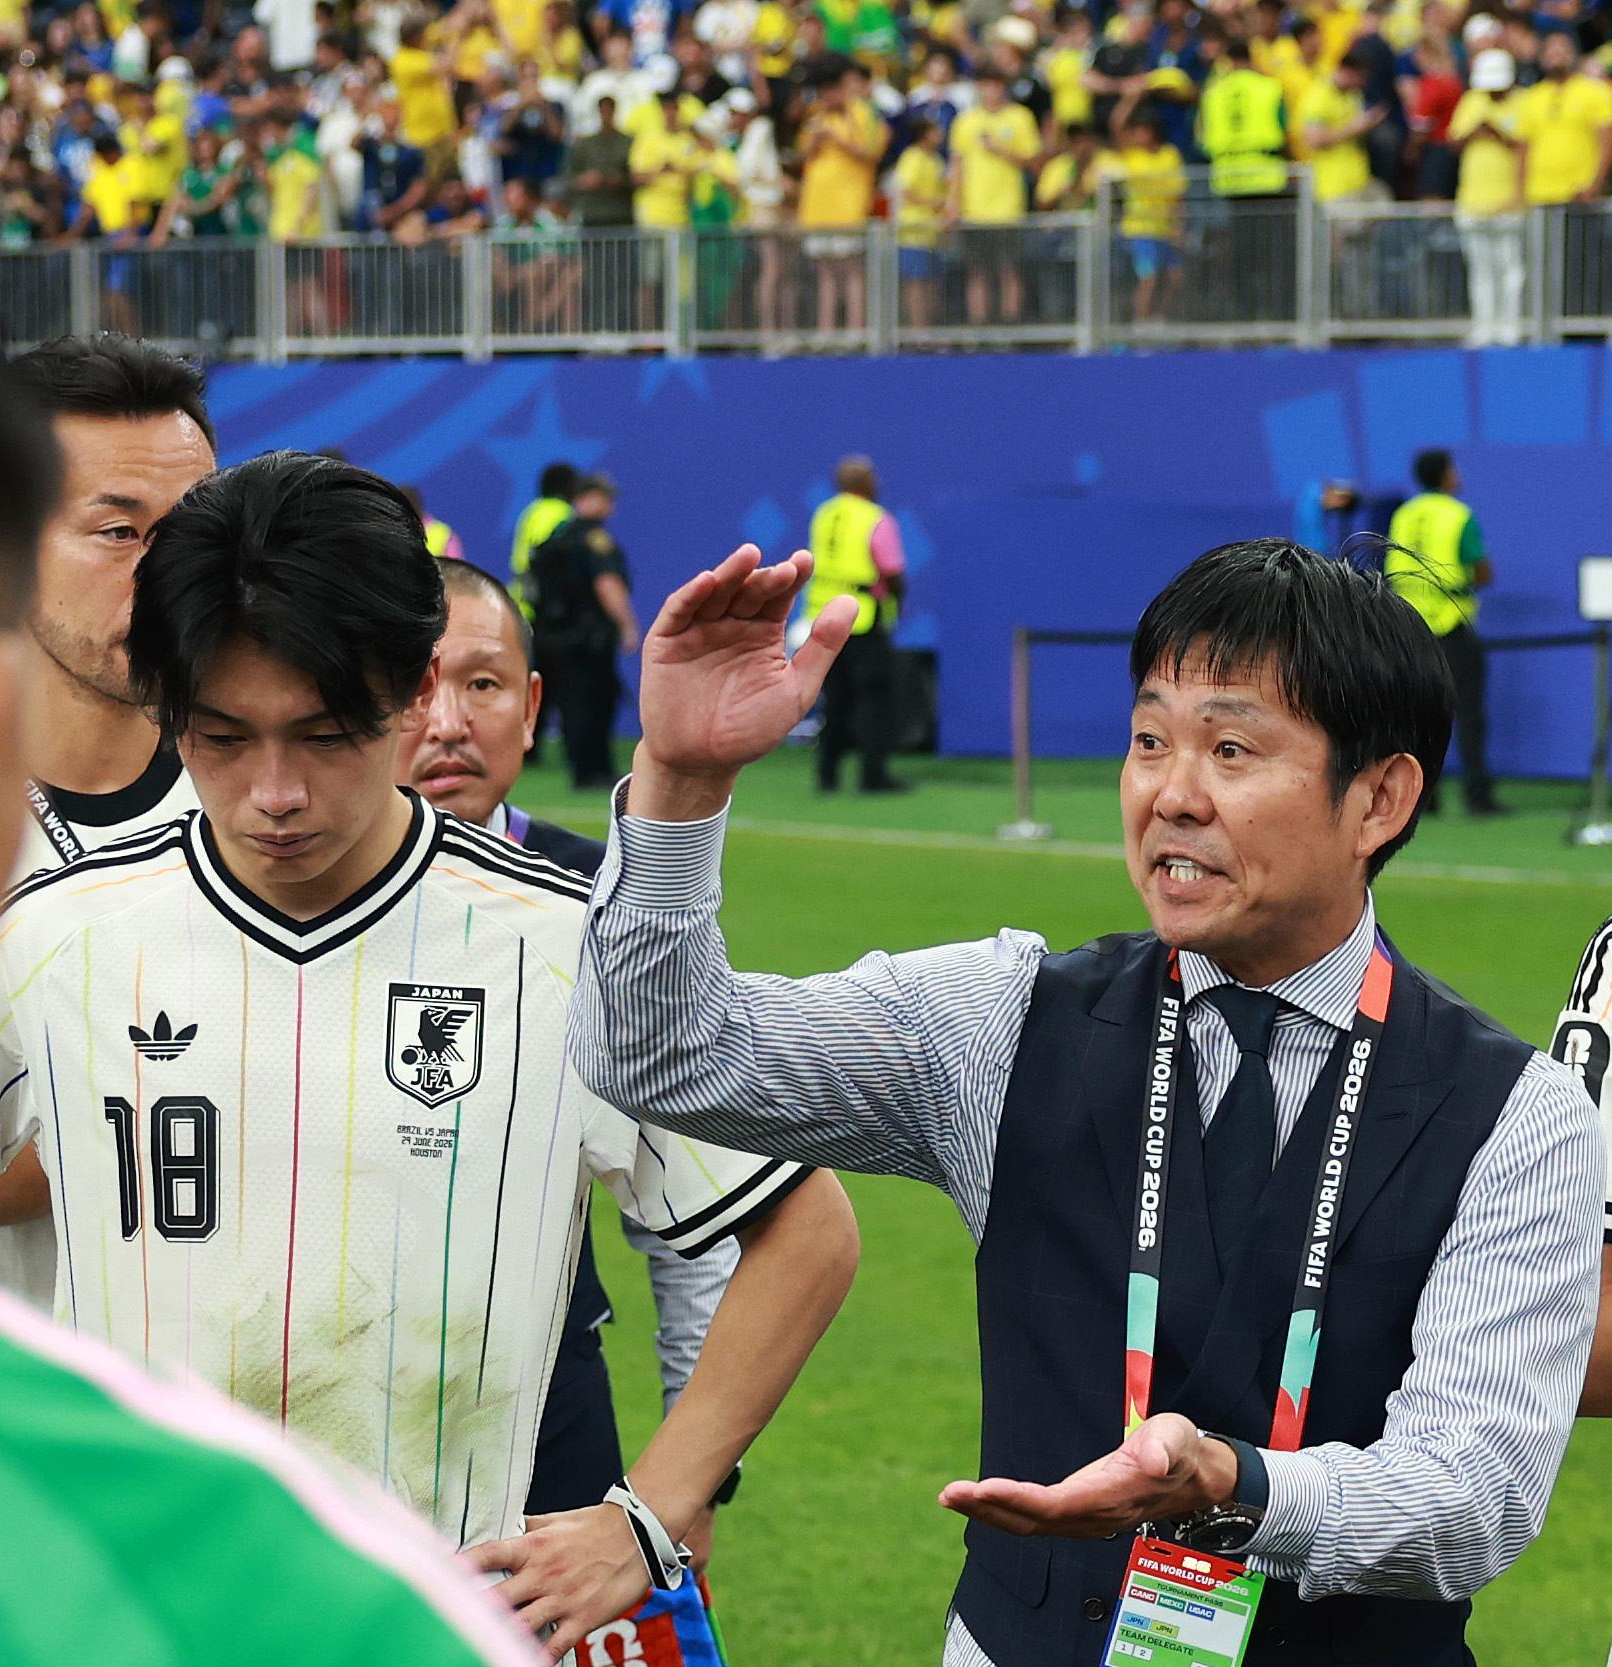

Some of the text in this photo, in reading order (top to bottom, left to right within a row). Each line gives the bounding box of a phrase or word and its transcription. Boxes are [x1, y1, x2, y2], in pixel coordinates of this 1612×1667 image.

[44, 811, 80, 862] WORL
[411, 986, 463, 1000] JAPAN
[410, 1066, 454, 1089] JFA
[397, 1125, 422, 1136] BRAZIL
[425, 1127, 434, 1136] VS
[1138, 997, 1180, 1249] FIFA WORLD CUP 2026
[410, 1148, 443, 1159] HOUSTON
[413, 1137, 432, 1147] JUNE
[434, 1138, 453, 1149] 2026
[104, 1096, 222, 1243] 18
[1304, 1038, 1372, 1289] FIFA WORLD CUP 2026
[1137, 1557, 1249, 1597] FIFA WORLD CUP 2026
[1127, 1617, 1144, 1626] JPN
[1156, 1626, 1174, 1634] JPN
[1121, 1628, 1195, 1656] TEAM DELEGATE
